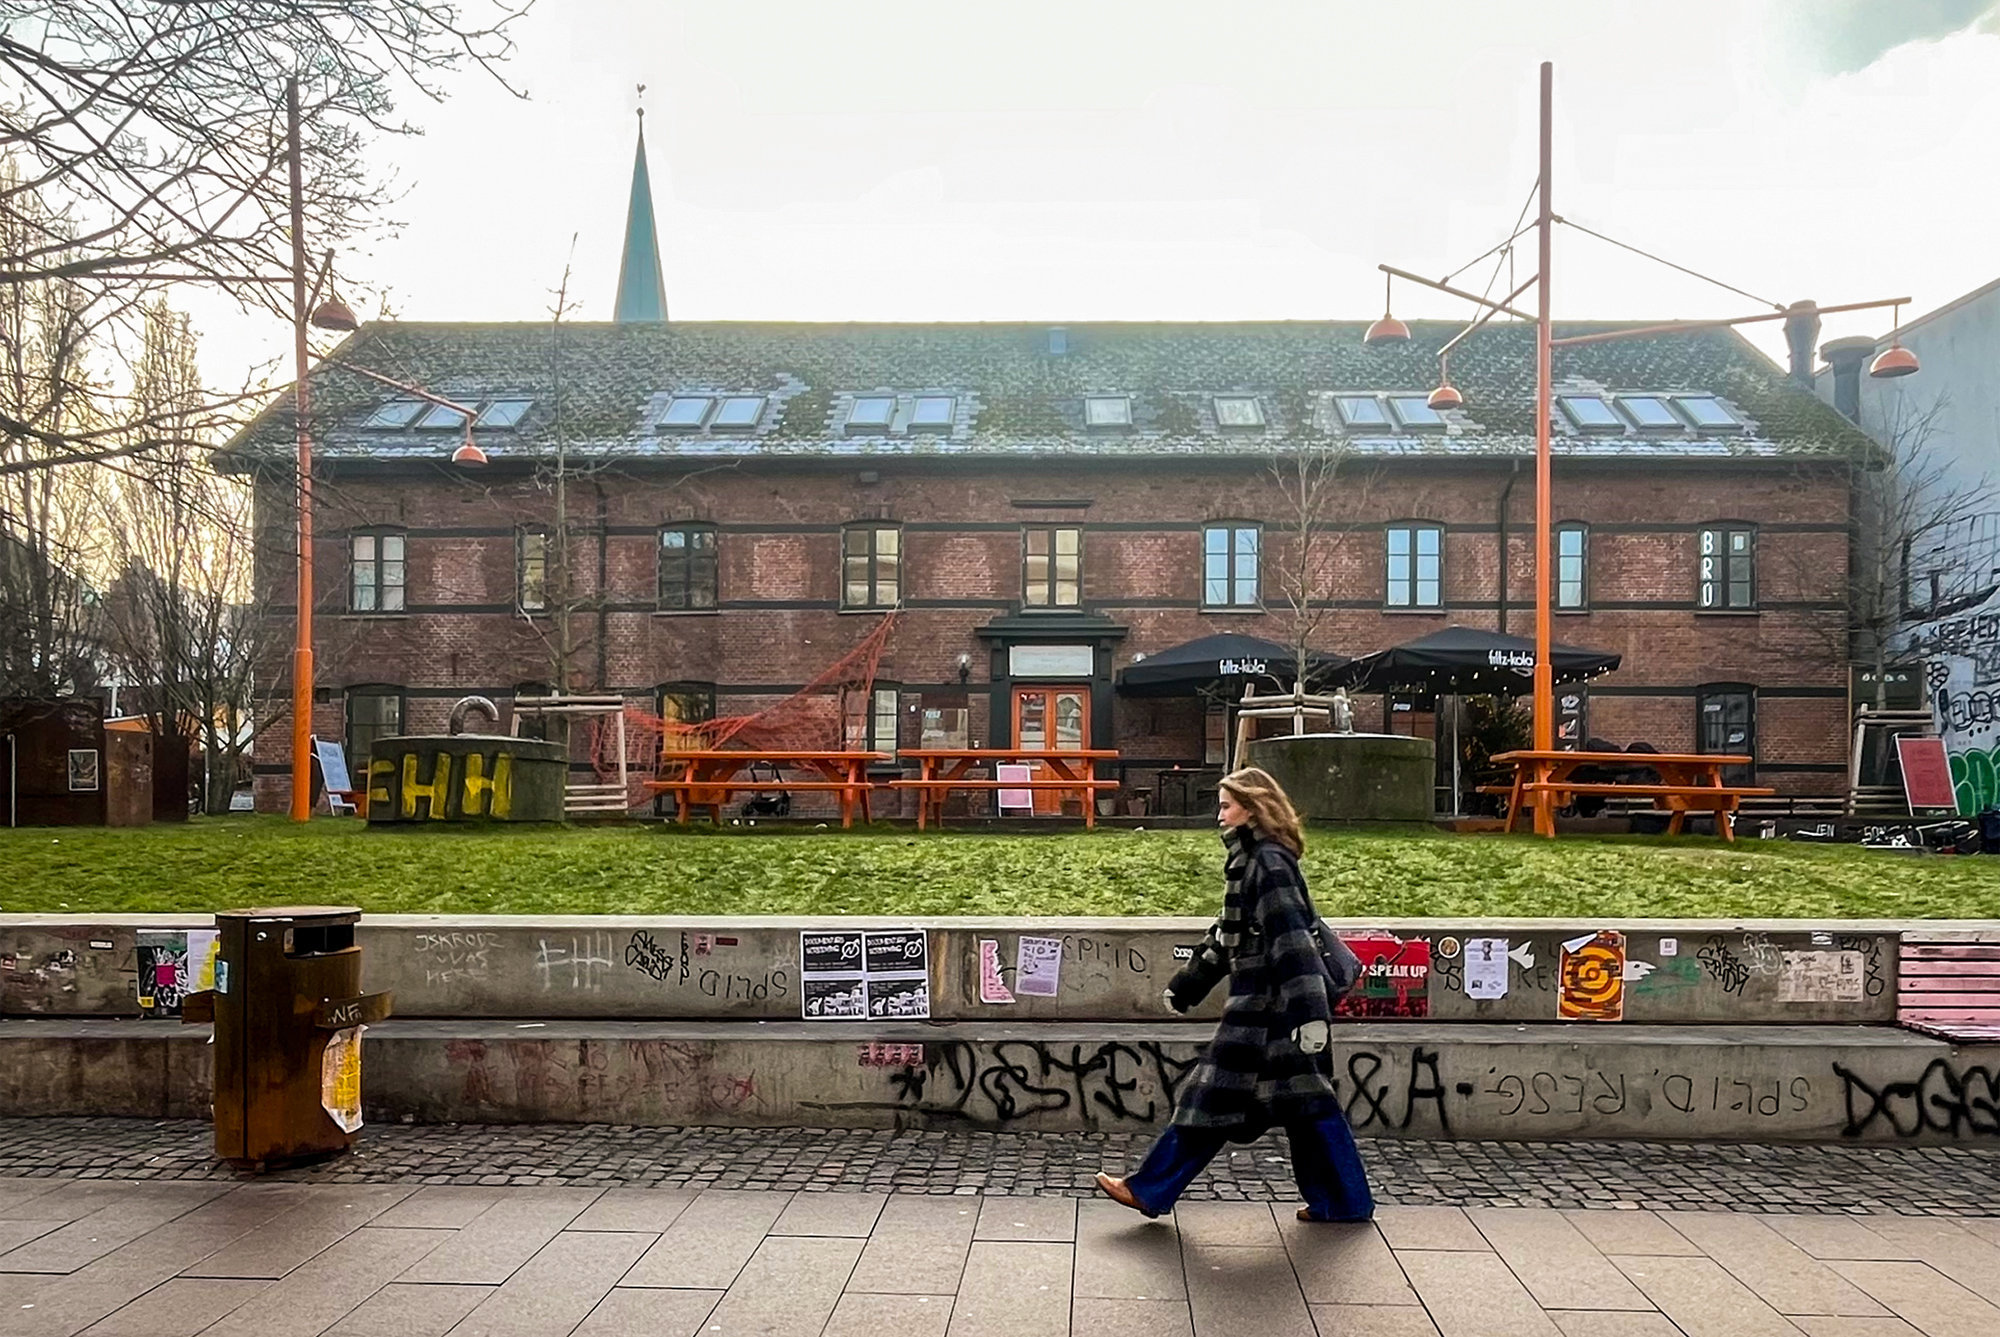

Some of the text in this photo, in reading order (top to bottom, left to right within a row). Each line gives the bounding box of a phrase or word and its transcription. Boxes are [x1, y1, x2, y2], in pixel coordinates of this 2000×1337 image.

[1488, 649, 1534, 667] fritz-kola
[1368, 964, 1409, 977] SPEAK
[1410, 964, 1428, 978] UP
